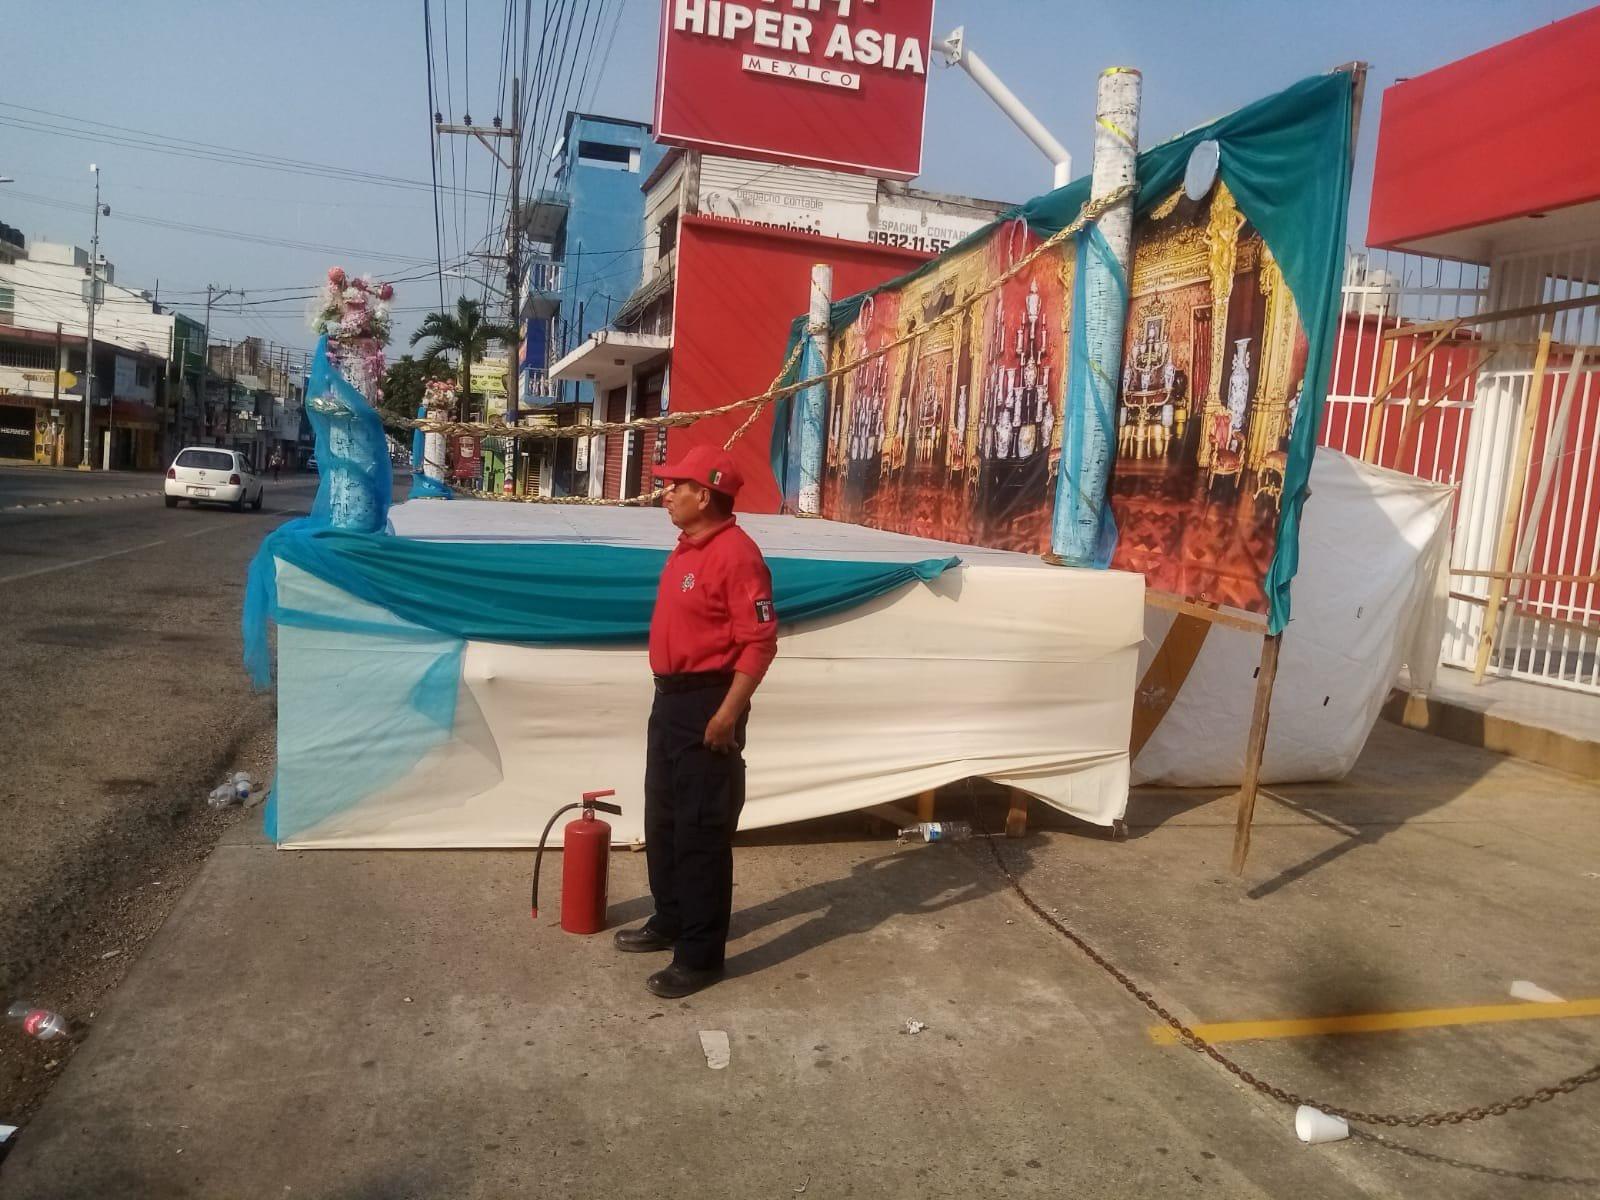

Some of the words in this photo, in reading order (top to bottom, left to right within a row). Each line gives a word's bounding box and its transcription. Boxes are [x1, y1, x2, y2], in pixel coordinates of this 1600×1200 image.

[674, 0, 812, 53] HIPER
[824, 23, 924, 74] ASIA
[748, 57, 852, 87] MEXICO
